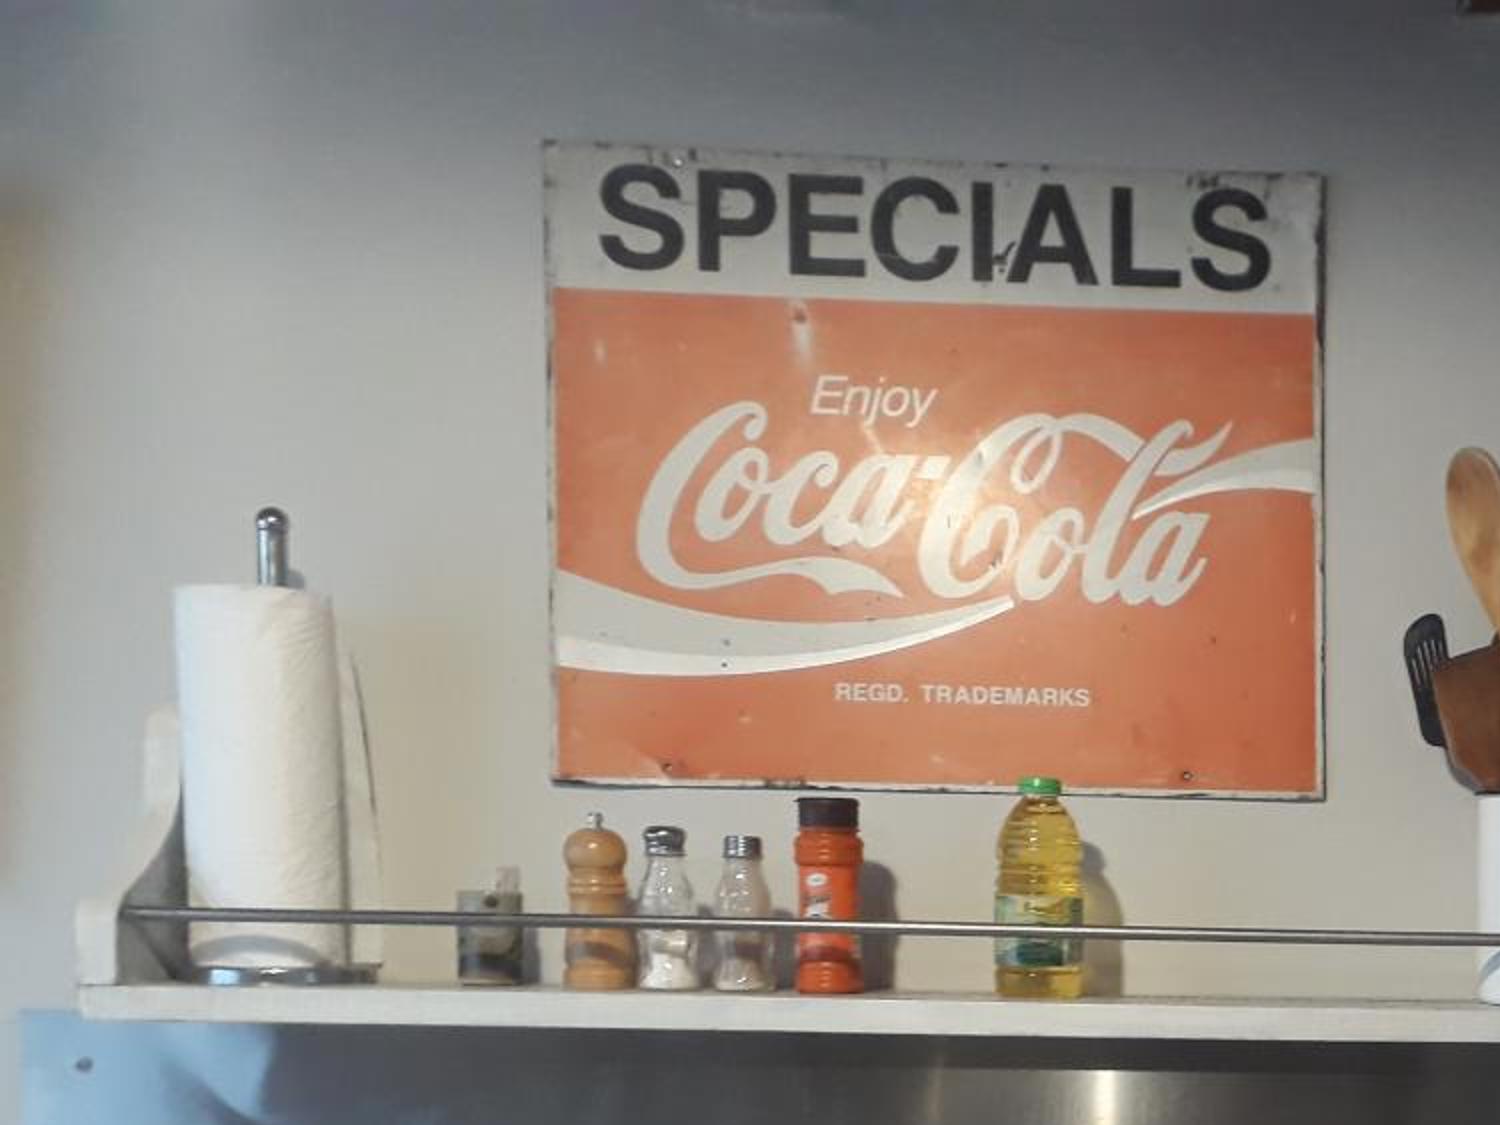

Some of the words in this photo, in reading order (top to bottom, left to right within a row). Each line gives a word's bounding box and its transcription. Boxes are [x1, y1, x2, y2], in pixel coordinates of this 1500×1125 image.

[599, 163, 1273, 293] SPECIALS
[809, 374, 938, 427] Enjoy
[635, 400, 1233, 607] Coca-Cola
[833, 682, 909, 705] REGD.
[919, 684, 1091, 708] TRADEMARKS
